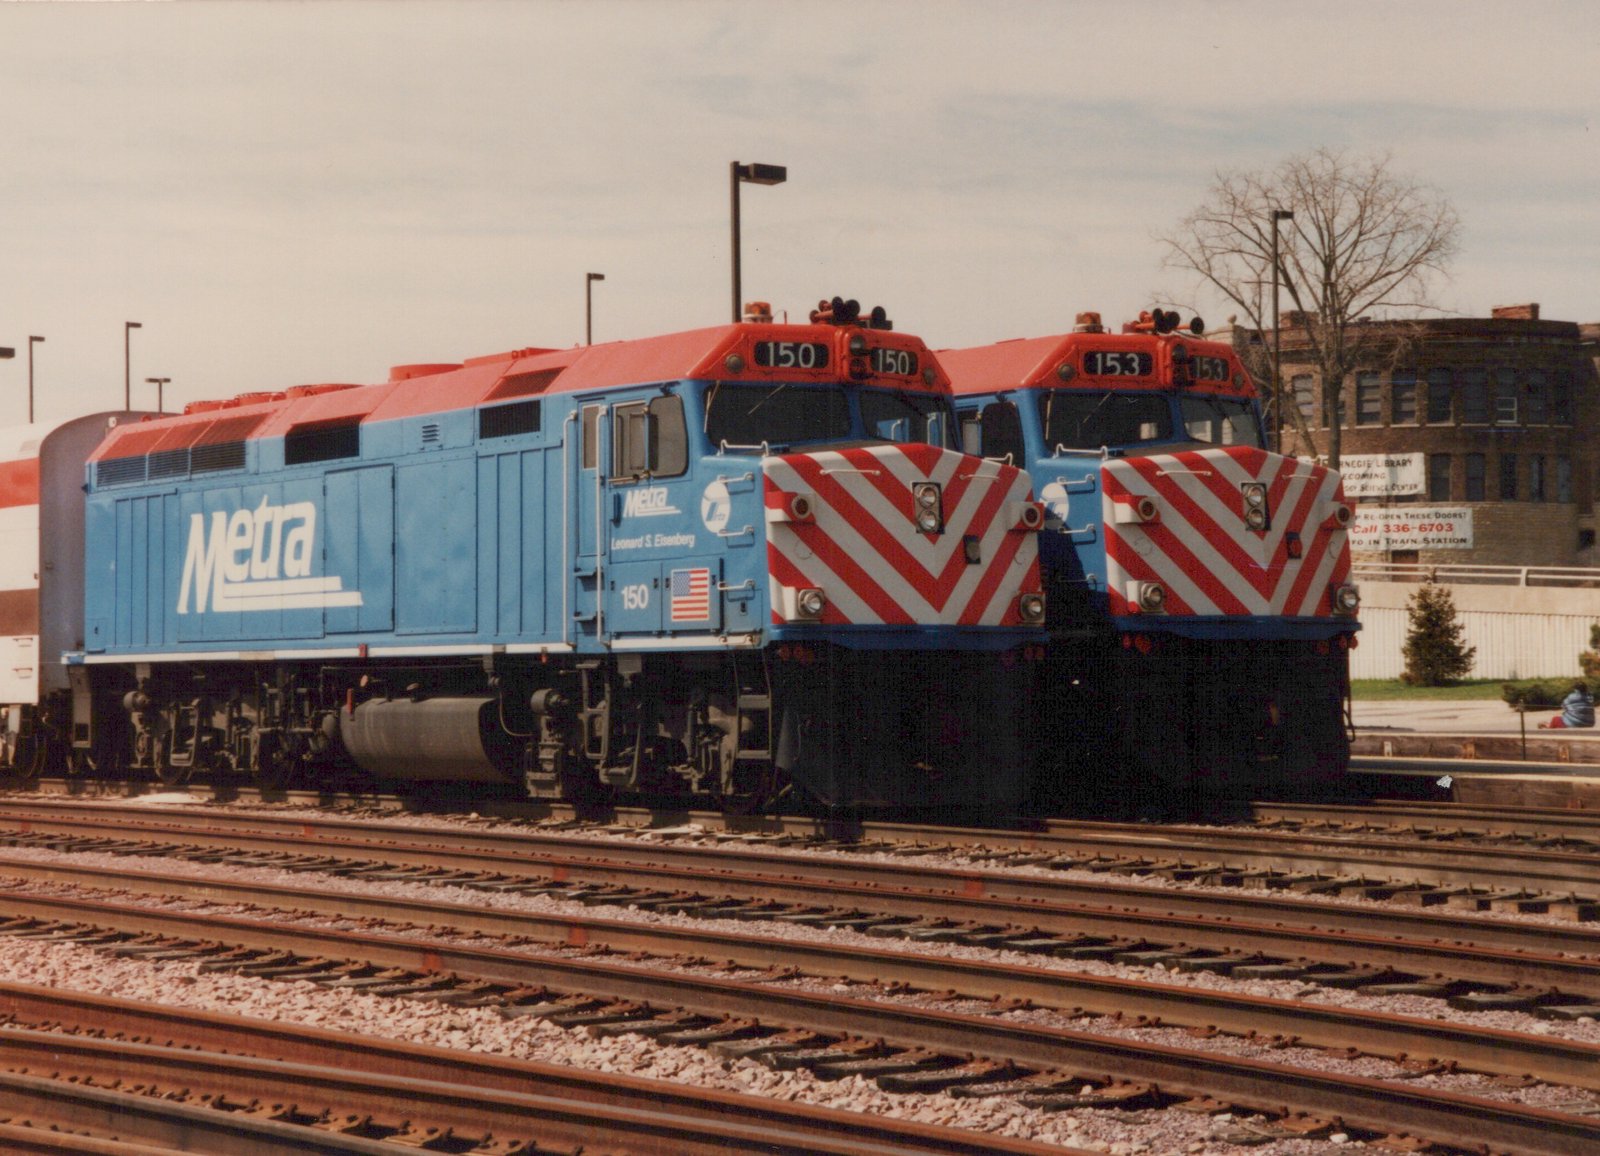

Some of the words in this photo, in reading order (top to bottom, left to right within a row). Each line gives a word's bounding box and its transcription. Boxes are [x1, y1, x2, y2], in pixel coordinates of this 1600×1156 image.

[767, 342, 815, 368] 150
[878, 349, 909, 375] 150
[1095, 353, 1139, 376] 153
[1195, 357, 1223, 380] 153
[623, 485, 668, 518] Metra
[1352, 525, 1377, 534] Call
[1383, 523, 1454, 533] 336-6703
[178, 494, 316, 614] Metra
[611, 537, 643, 550] Leonard
[654, 533, 695, 548] Eisenberg
[621, 584, 649, 609] 150
